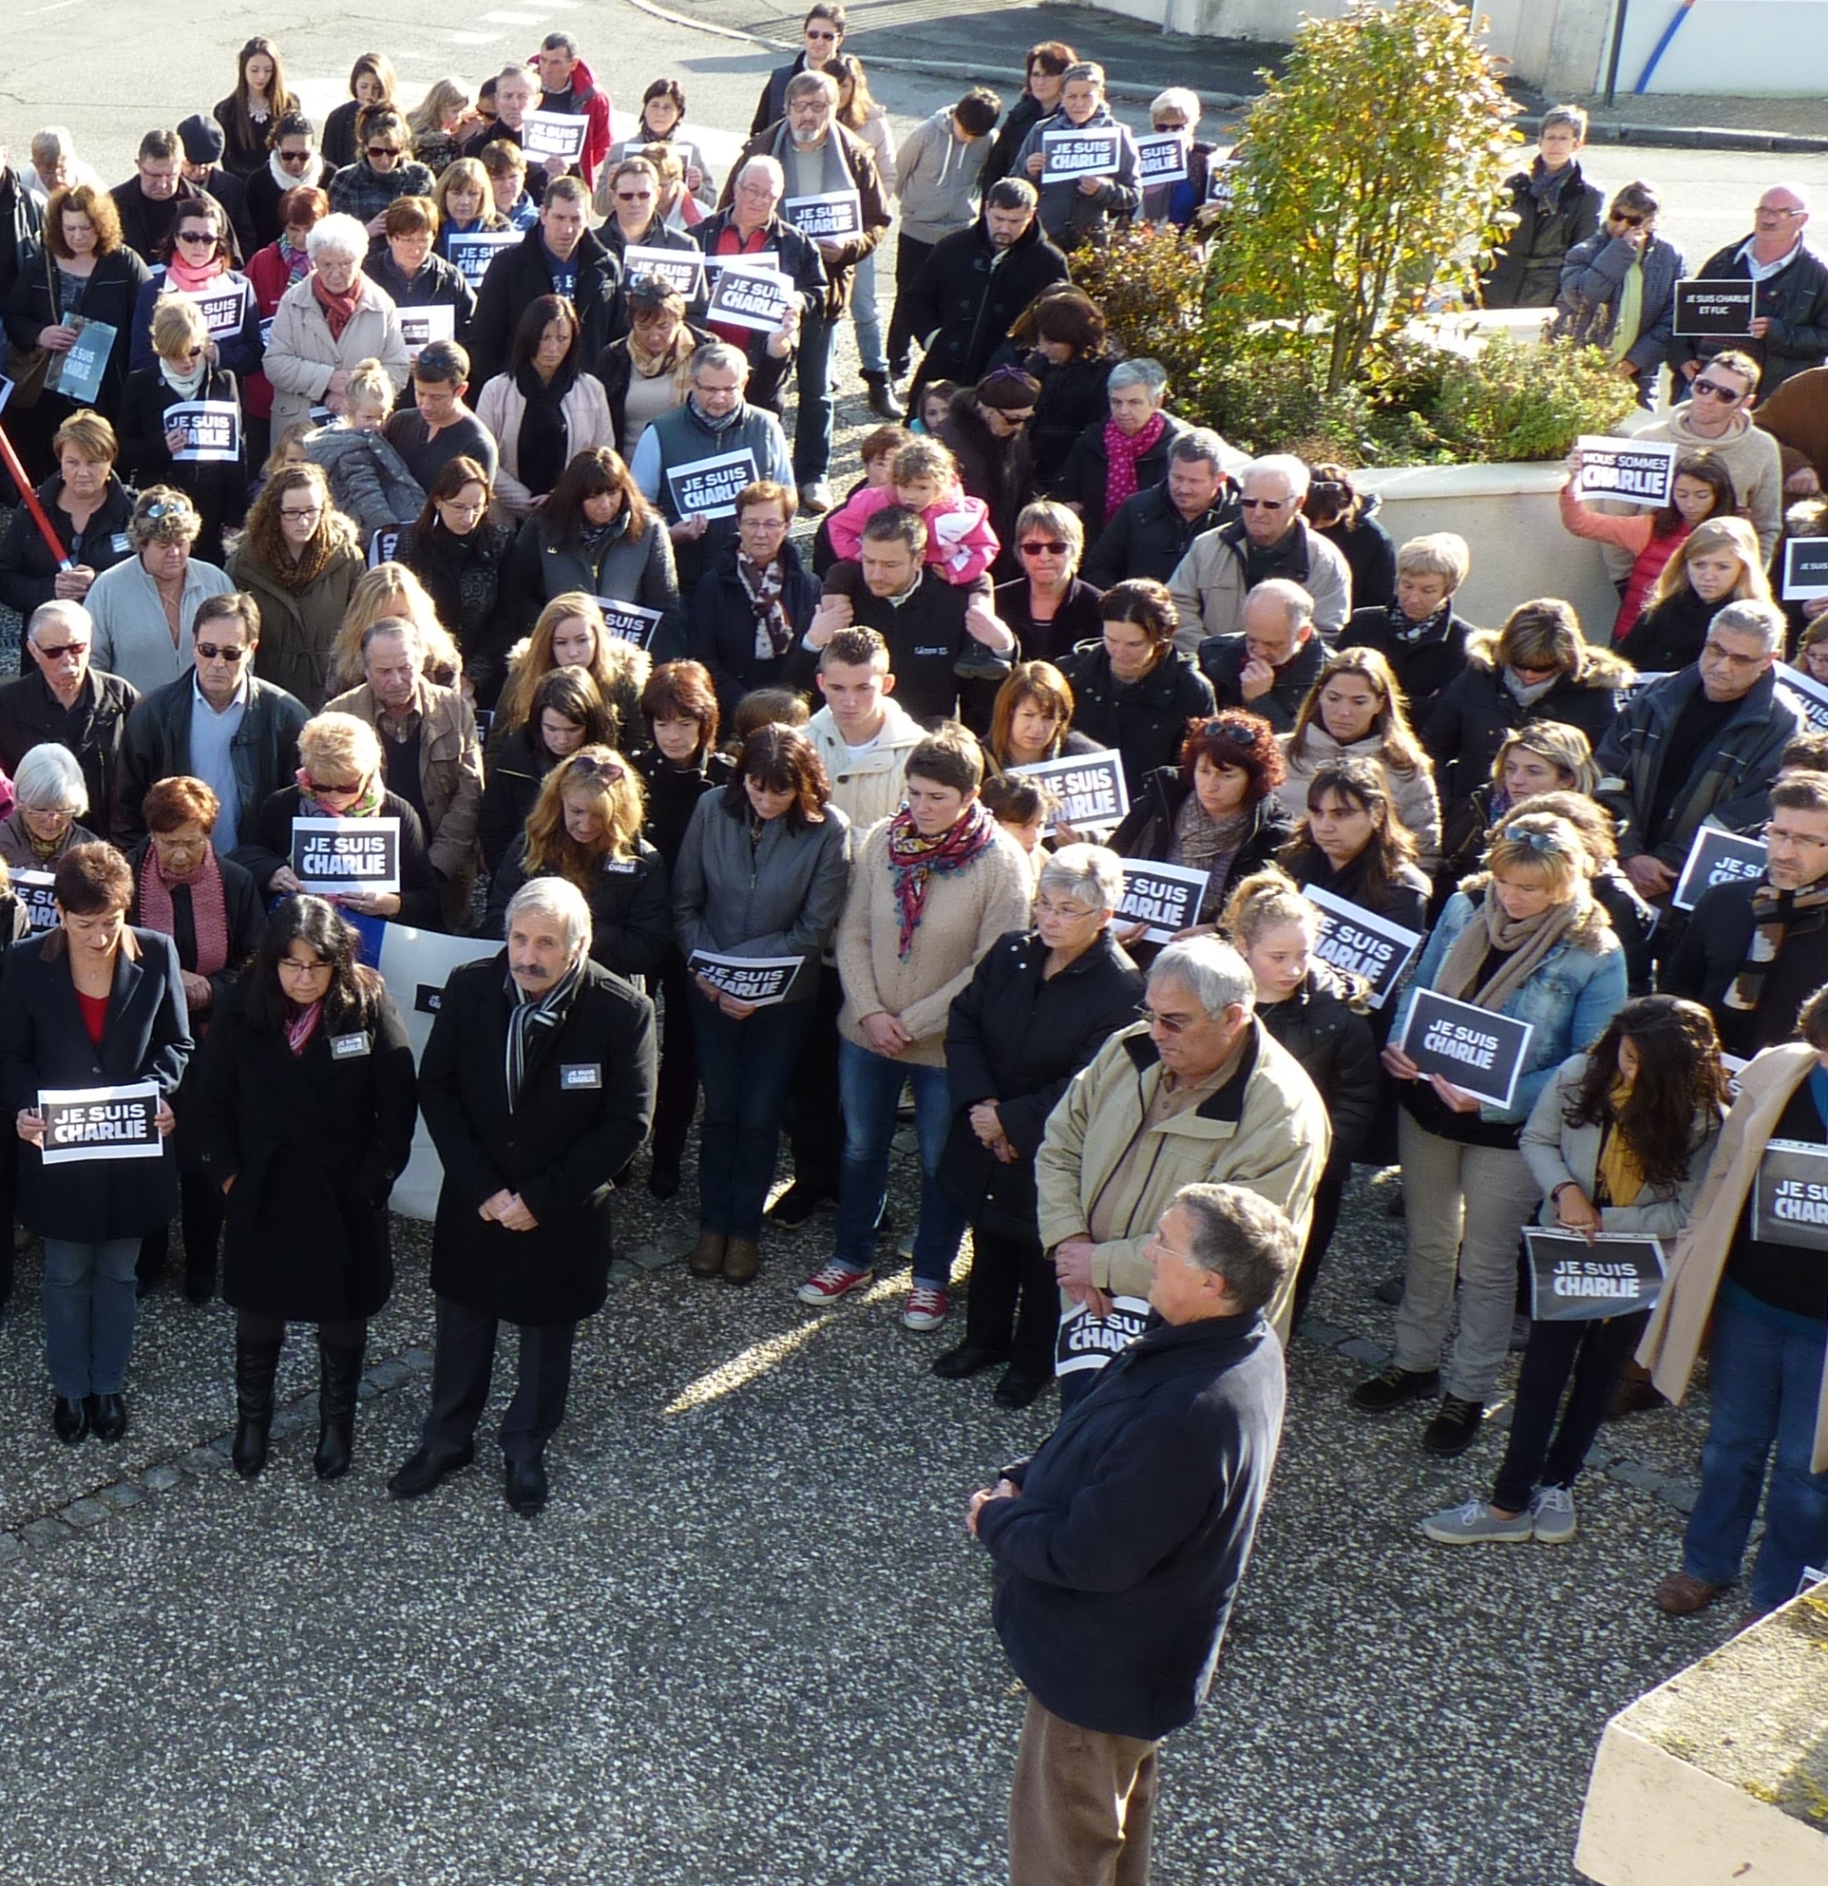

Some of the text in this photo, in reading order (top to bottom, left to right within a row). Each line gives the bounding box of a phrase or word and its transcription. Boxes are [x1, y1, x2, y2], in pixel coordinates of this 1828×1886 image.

[1052, 141, 1110, 155] JE SUIS
[1142, 145, 1177, 160] SUIS
[1051, 153, 1111, 170] CHARLIE
[1141, 157, 1179, 175] ARLIE
[796, 204, 852, 221] JE SUIS
[797, 216, 854, 237] CHARLIE
[458, 247, 477, 259] JE
[632, 262, 693, 278] JE SUIS
[727, 279, 751, 293] JE
[203, 298, 238, 316] SUIS
[721, 290, 787, 320] CHARLIE
[169, 414, 231, 430] JE SUIS
[1583, 452, 1668, 471] NOUS SOMMES
[681, 466, 747, 493] JE SUIS
[1582, 464, 1666, 496] CHARLIE
[605, 613, 645, 632] SUIS
[1063, 766, 1114, 797] SUIS
[303, 836, 386, 854] JE SUIS
[303, 854, 386, 876] CHARLIE
[1714, 856, 1744, 874] JE
[1133, 877, 1189, 904] SUIS
[1335, 926, 1395, 963] SUIS
[700, 965, 785, 982] JE SUIS
[1429, 1019, 1499, 1052] JE SUIS
[1423, 1032, 1497, 1071] CHARLIE
[54, 1103, 147, 1125] JE SUIS
[54, 1120, 149, 1143] CHARLIE
[1775, 1180, 1805, 1199] JE
[1774, 1198, 1828, 1226] CHAR
[1554, 1260, 1639, 1278] JE SUIS
[1553, 1277, 1641, 1299] CHARLIE
